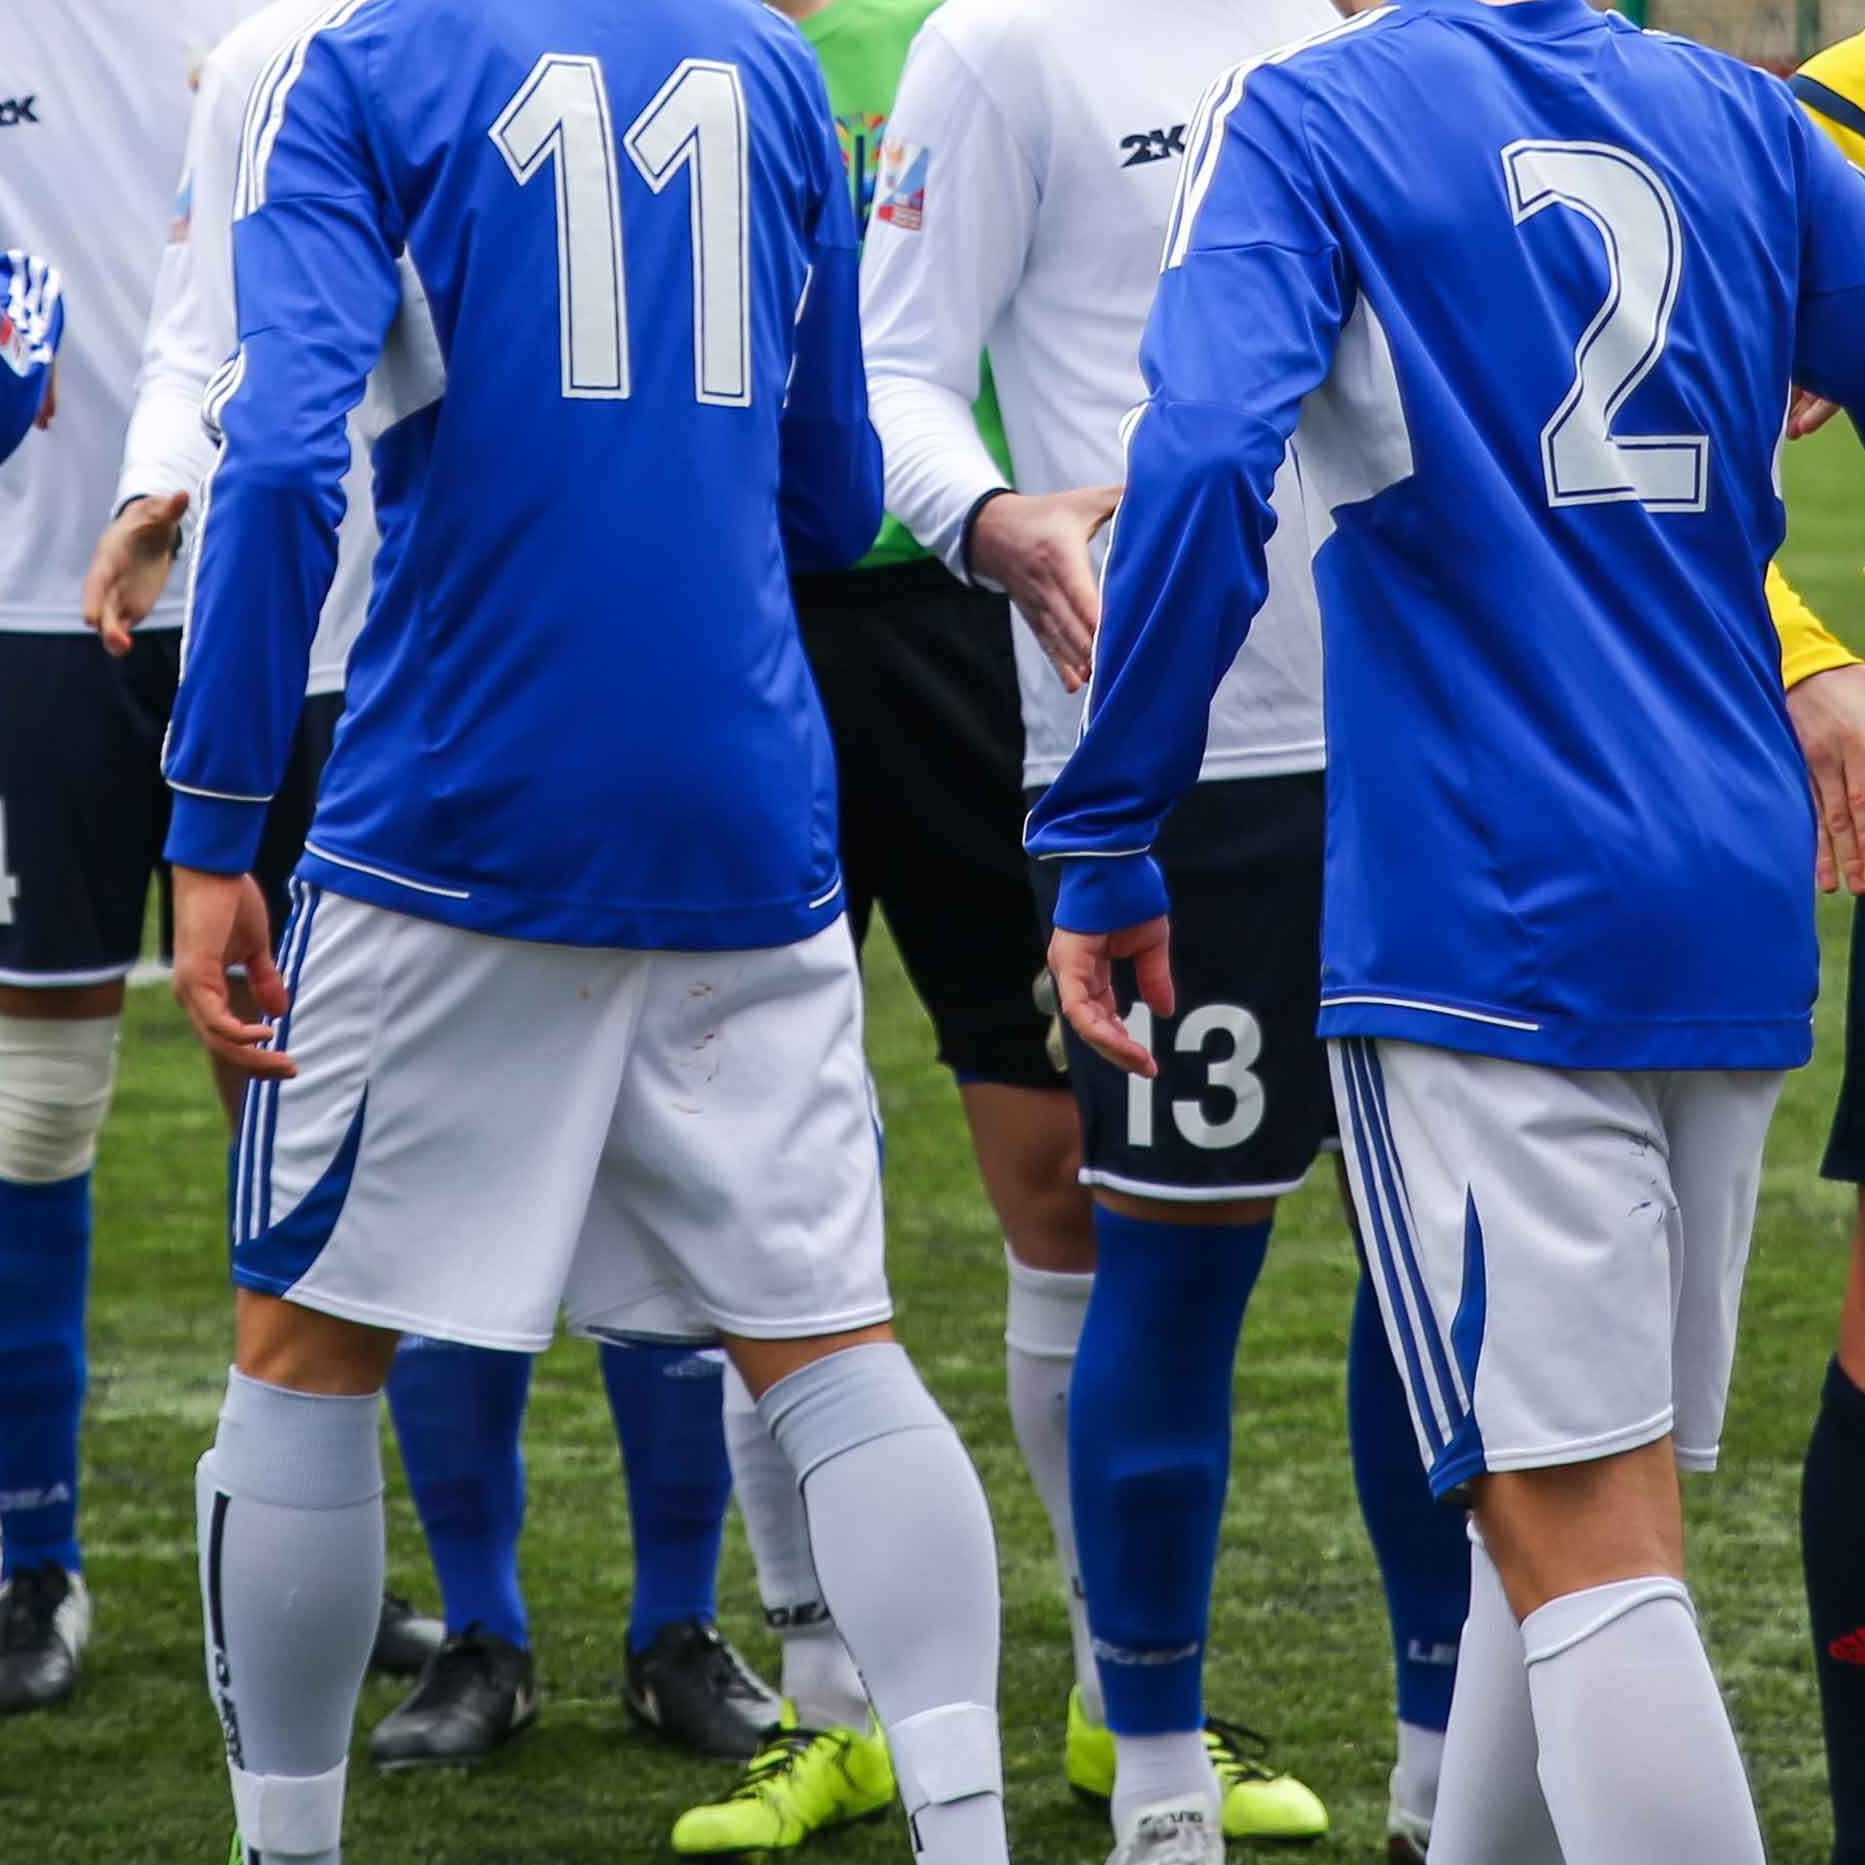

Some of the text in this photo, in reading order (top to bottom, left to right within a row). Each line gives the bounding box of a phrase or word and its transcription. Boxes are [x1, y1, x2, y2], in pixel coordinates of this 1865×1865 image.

[488, 52, 751, 408] 11
[1121, 124, 1186, 168] 2K
[1501, 139, 1710, 513] 2
[1123, 1002, 1265, 1149] 13
